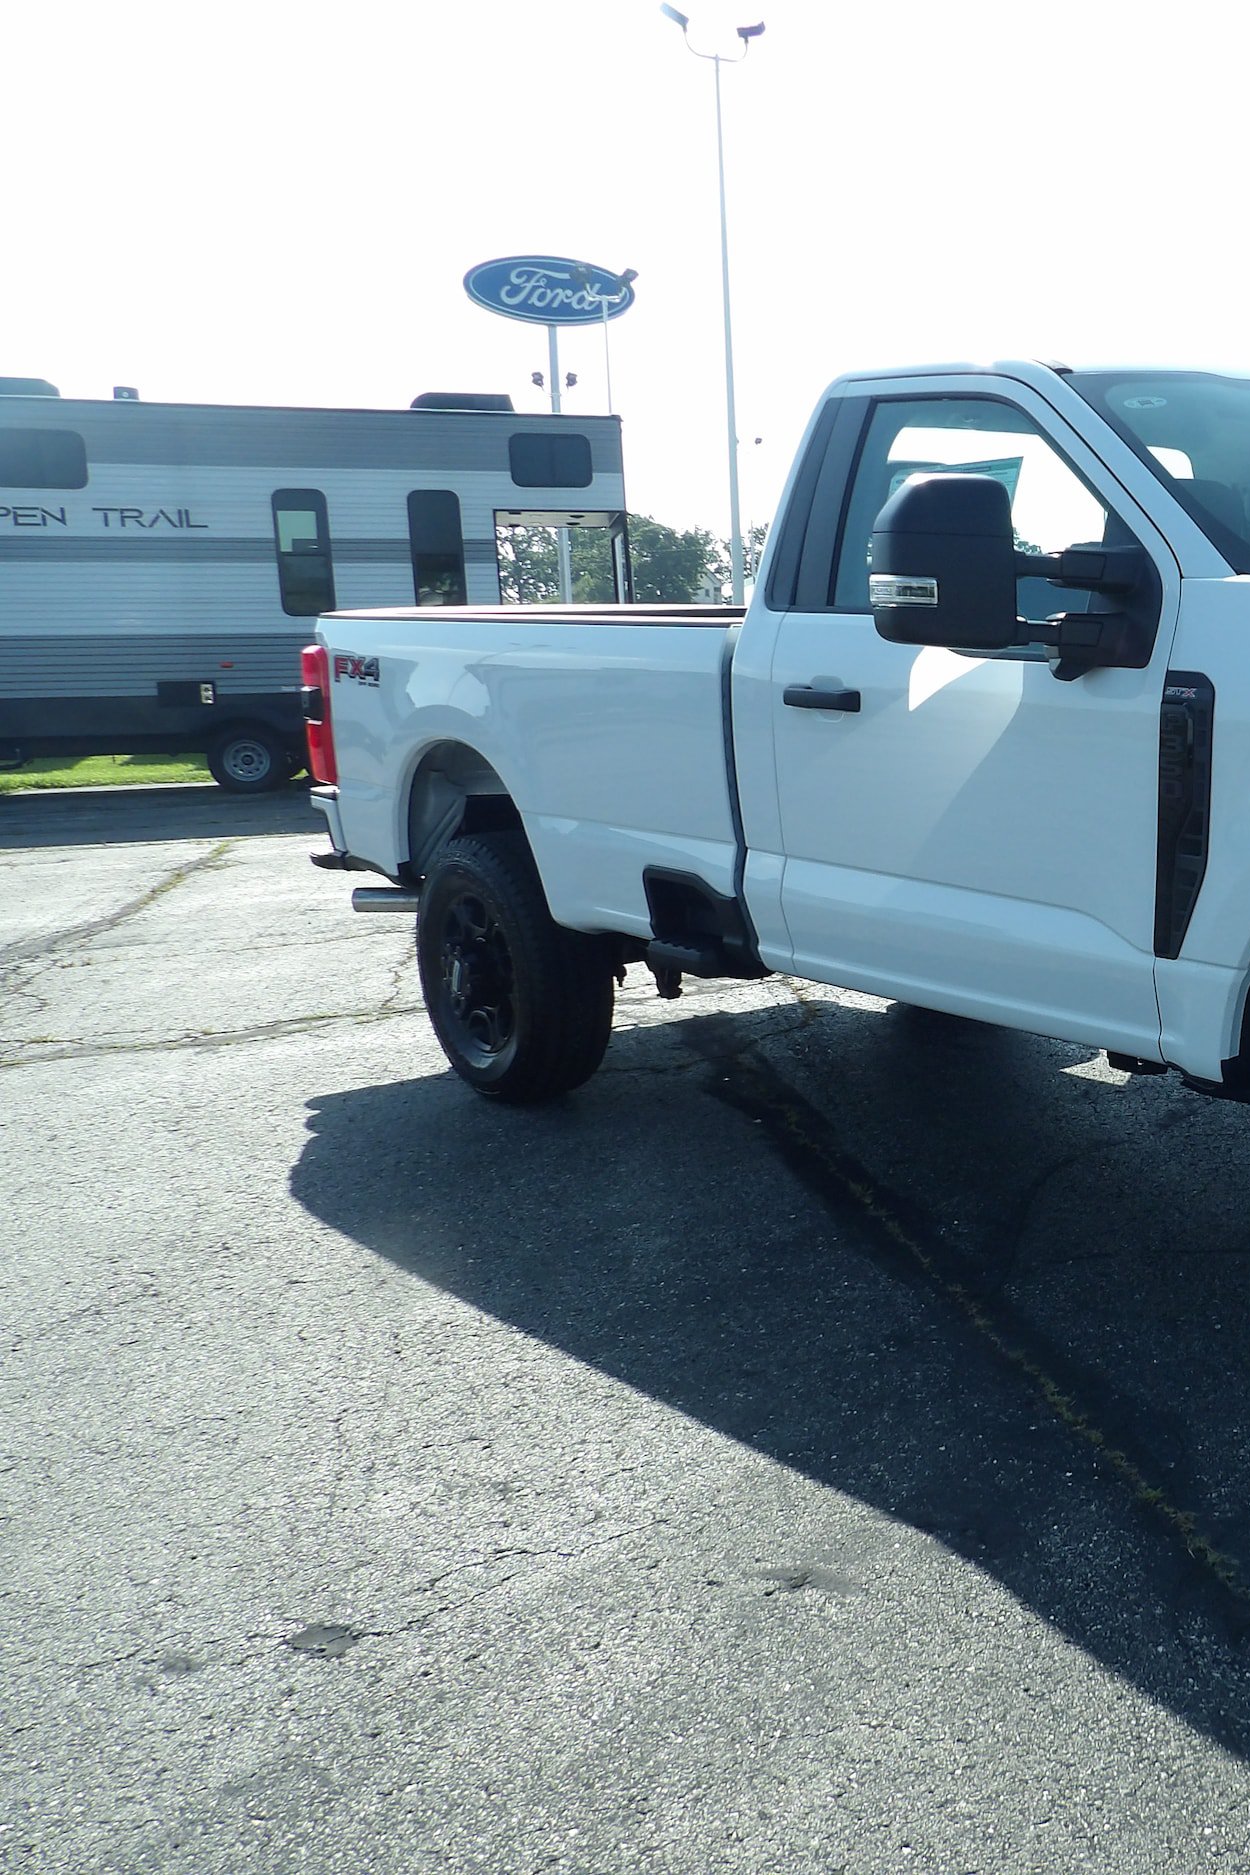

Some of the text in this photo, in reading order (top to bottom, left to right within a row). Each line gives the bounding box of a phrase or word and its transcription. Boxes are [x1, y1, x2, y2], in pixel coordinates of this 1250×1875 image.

[500, 266, 602, 310] Ford
[92, 507, 208, 529] TRAIL
[334, 655, 380, 682] FX4
